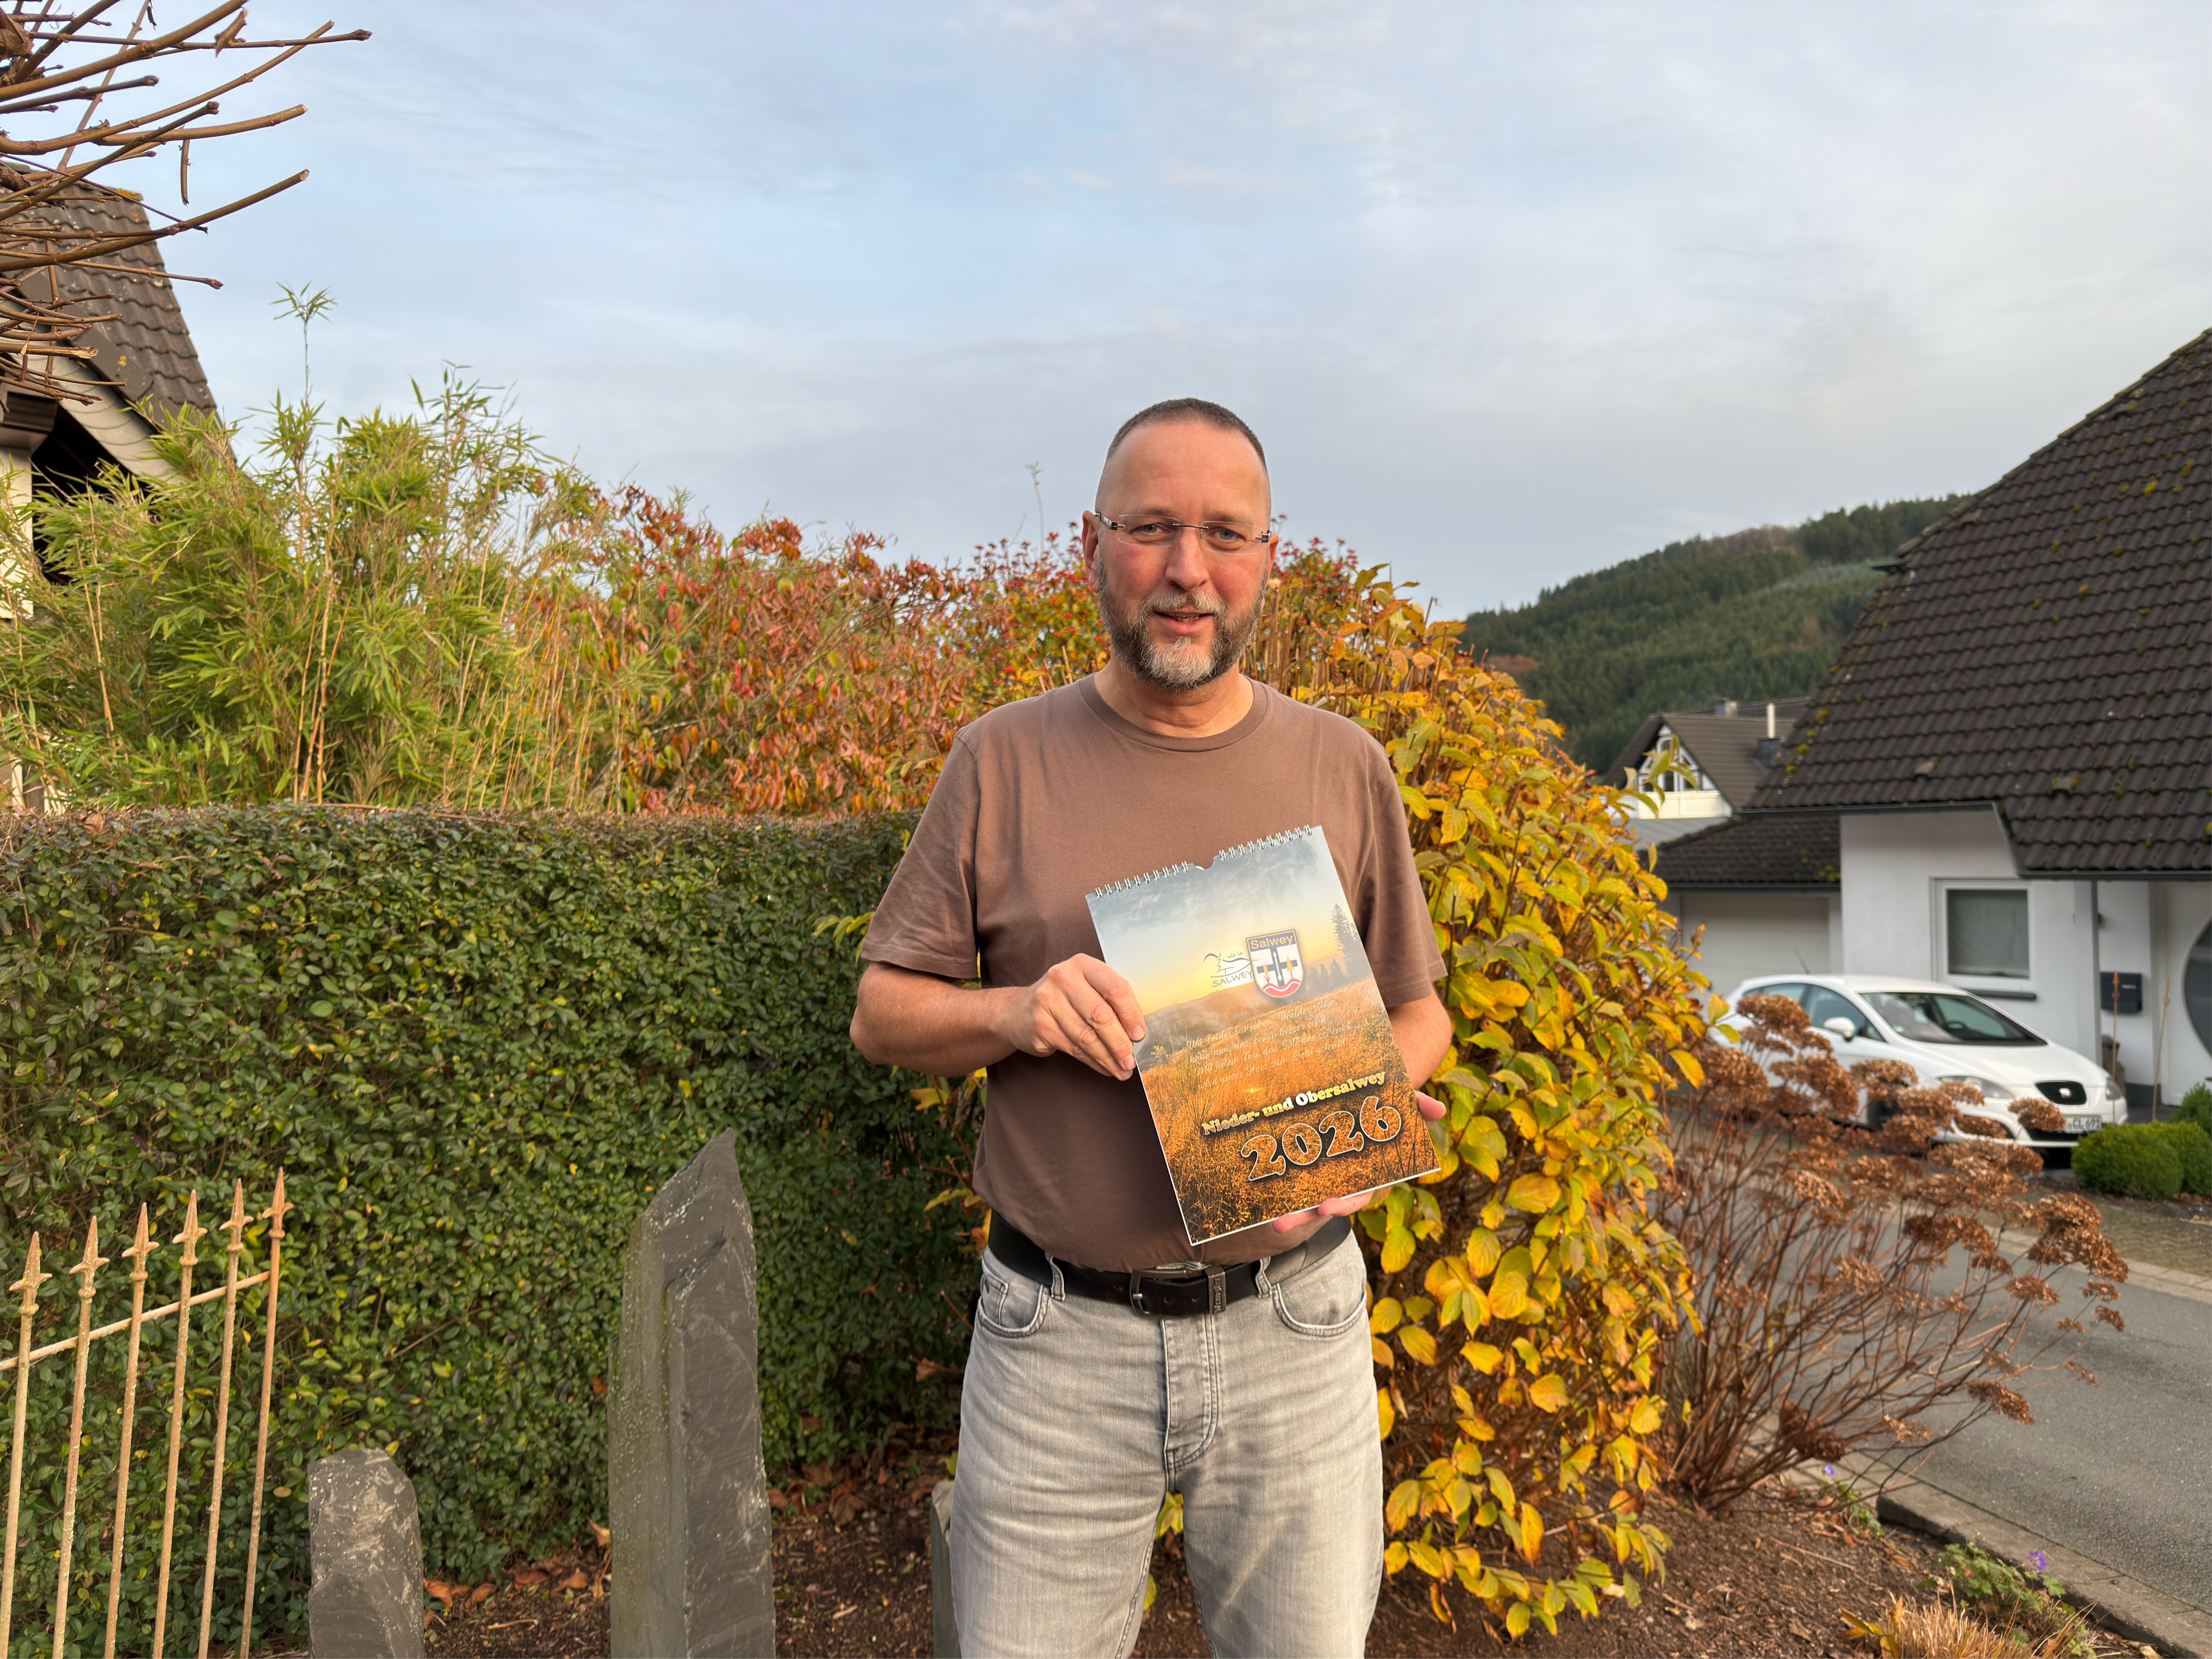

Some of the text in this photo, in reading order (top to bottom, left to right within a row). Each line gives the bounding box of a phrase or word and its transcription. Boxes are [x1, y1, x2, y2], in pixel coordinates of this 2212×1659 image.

[1250, 935, 1293, 950] Salwey
[1212, 968, 1253, 987] SALWEY
[1187, 998, 1337, 1050] Wo Felder rauschen, Wälder stehn,
[1190, 1015, 1329, 1063] kann man das Leben besser sehn.
[1195, 1022, 1352, 1077] Mit jedem Tag, den Gott uns schenkt,
[1198, 1036, 1348, 1090] wird unser Herz zum Licht gelenkt.
[1201, 1071, 1386, 1136] Nieder- und Obersalwey
[1241, 1096, 1401, 1181] 2026
[1214, 1278, 1222, 1313] Wrangler
